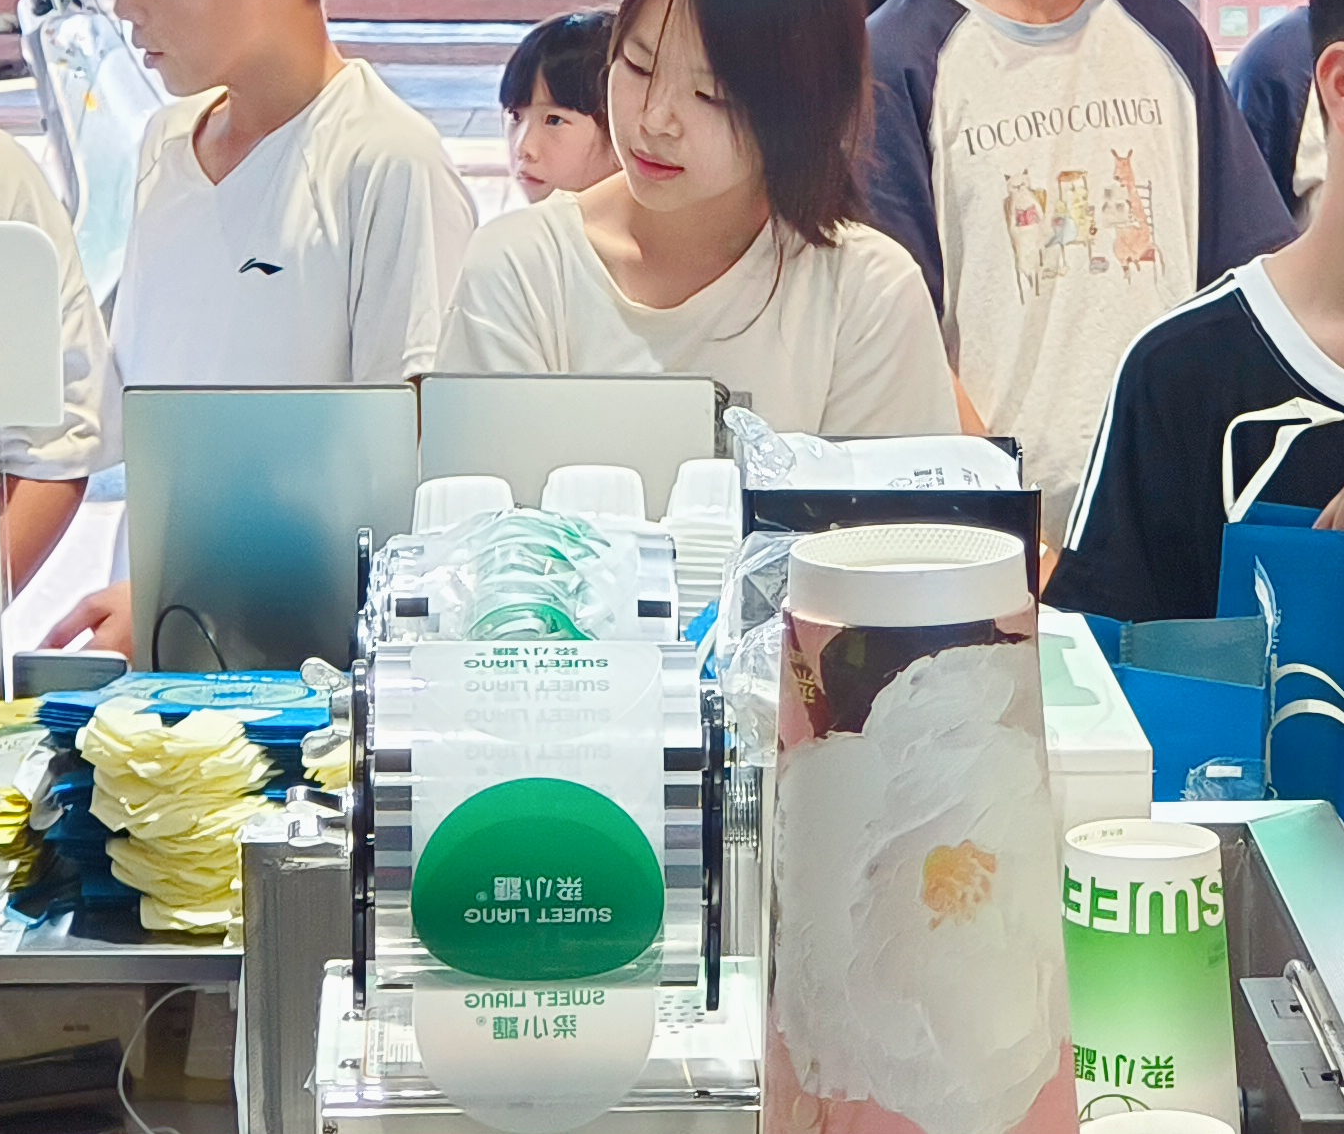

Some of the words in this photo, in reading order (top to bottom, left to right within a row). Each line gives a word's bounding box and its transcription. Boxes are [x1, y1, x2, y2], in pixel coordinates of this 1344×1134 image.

[463, 658, 528, 668] LIANG
[535, 658, 609, 668] SWEET
[1062, 869, 1225, 935] SWEE
[463, 907, 530, 924] LIANG
[536, 907, 613, 923] SWEET
